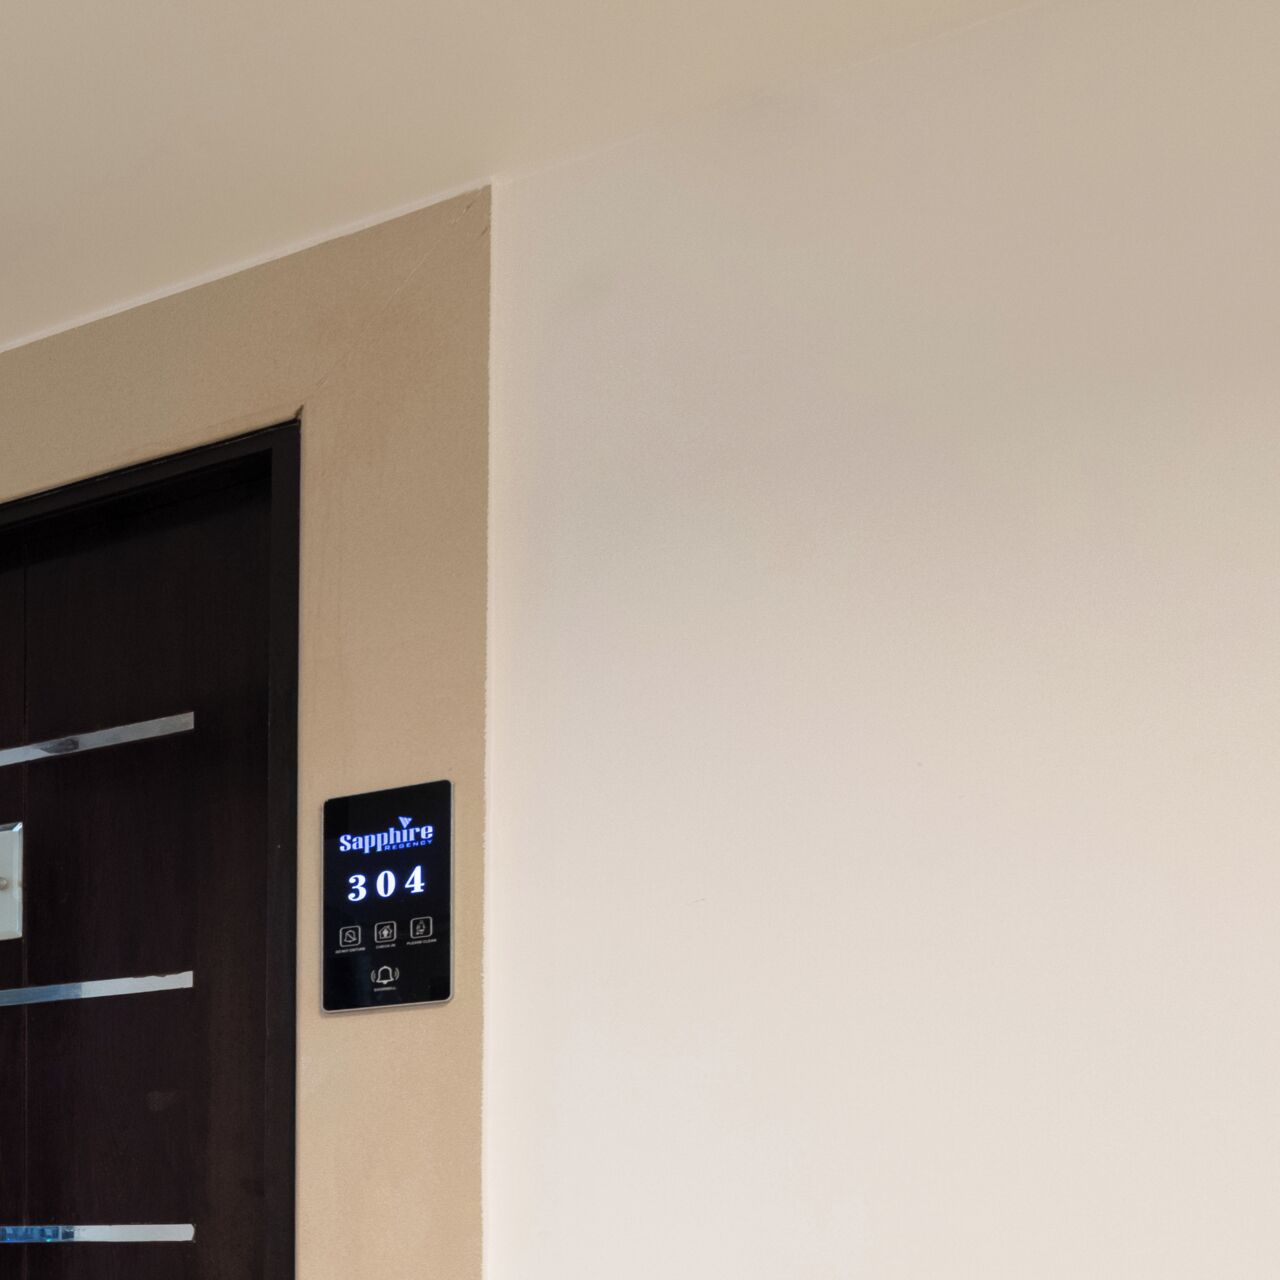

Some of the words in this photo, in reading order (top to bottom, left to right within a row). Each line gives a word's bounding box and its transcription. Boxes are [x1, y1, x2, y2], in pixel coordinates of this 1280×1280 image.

[339, 825, 433, 854] Sapphire
[383, 839, 433, 851] REGENCY
[347, 865, 425, 902] 304
